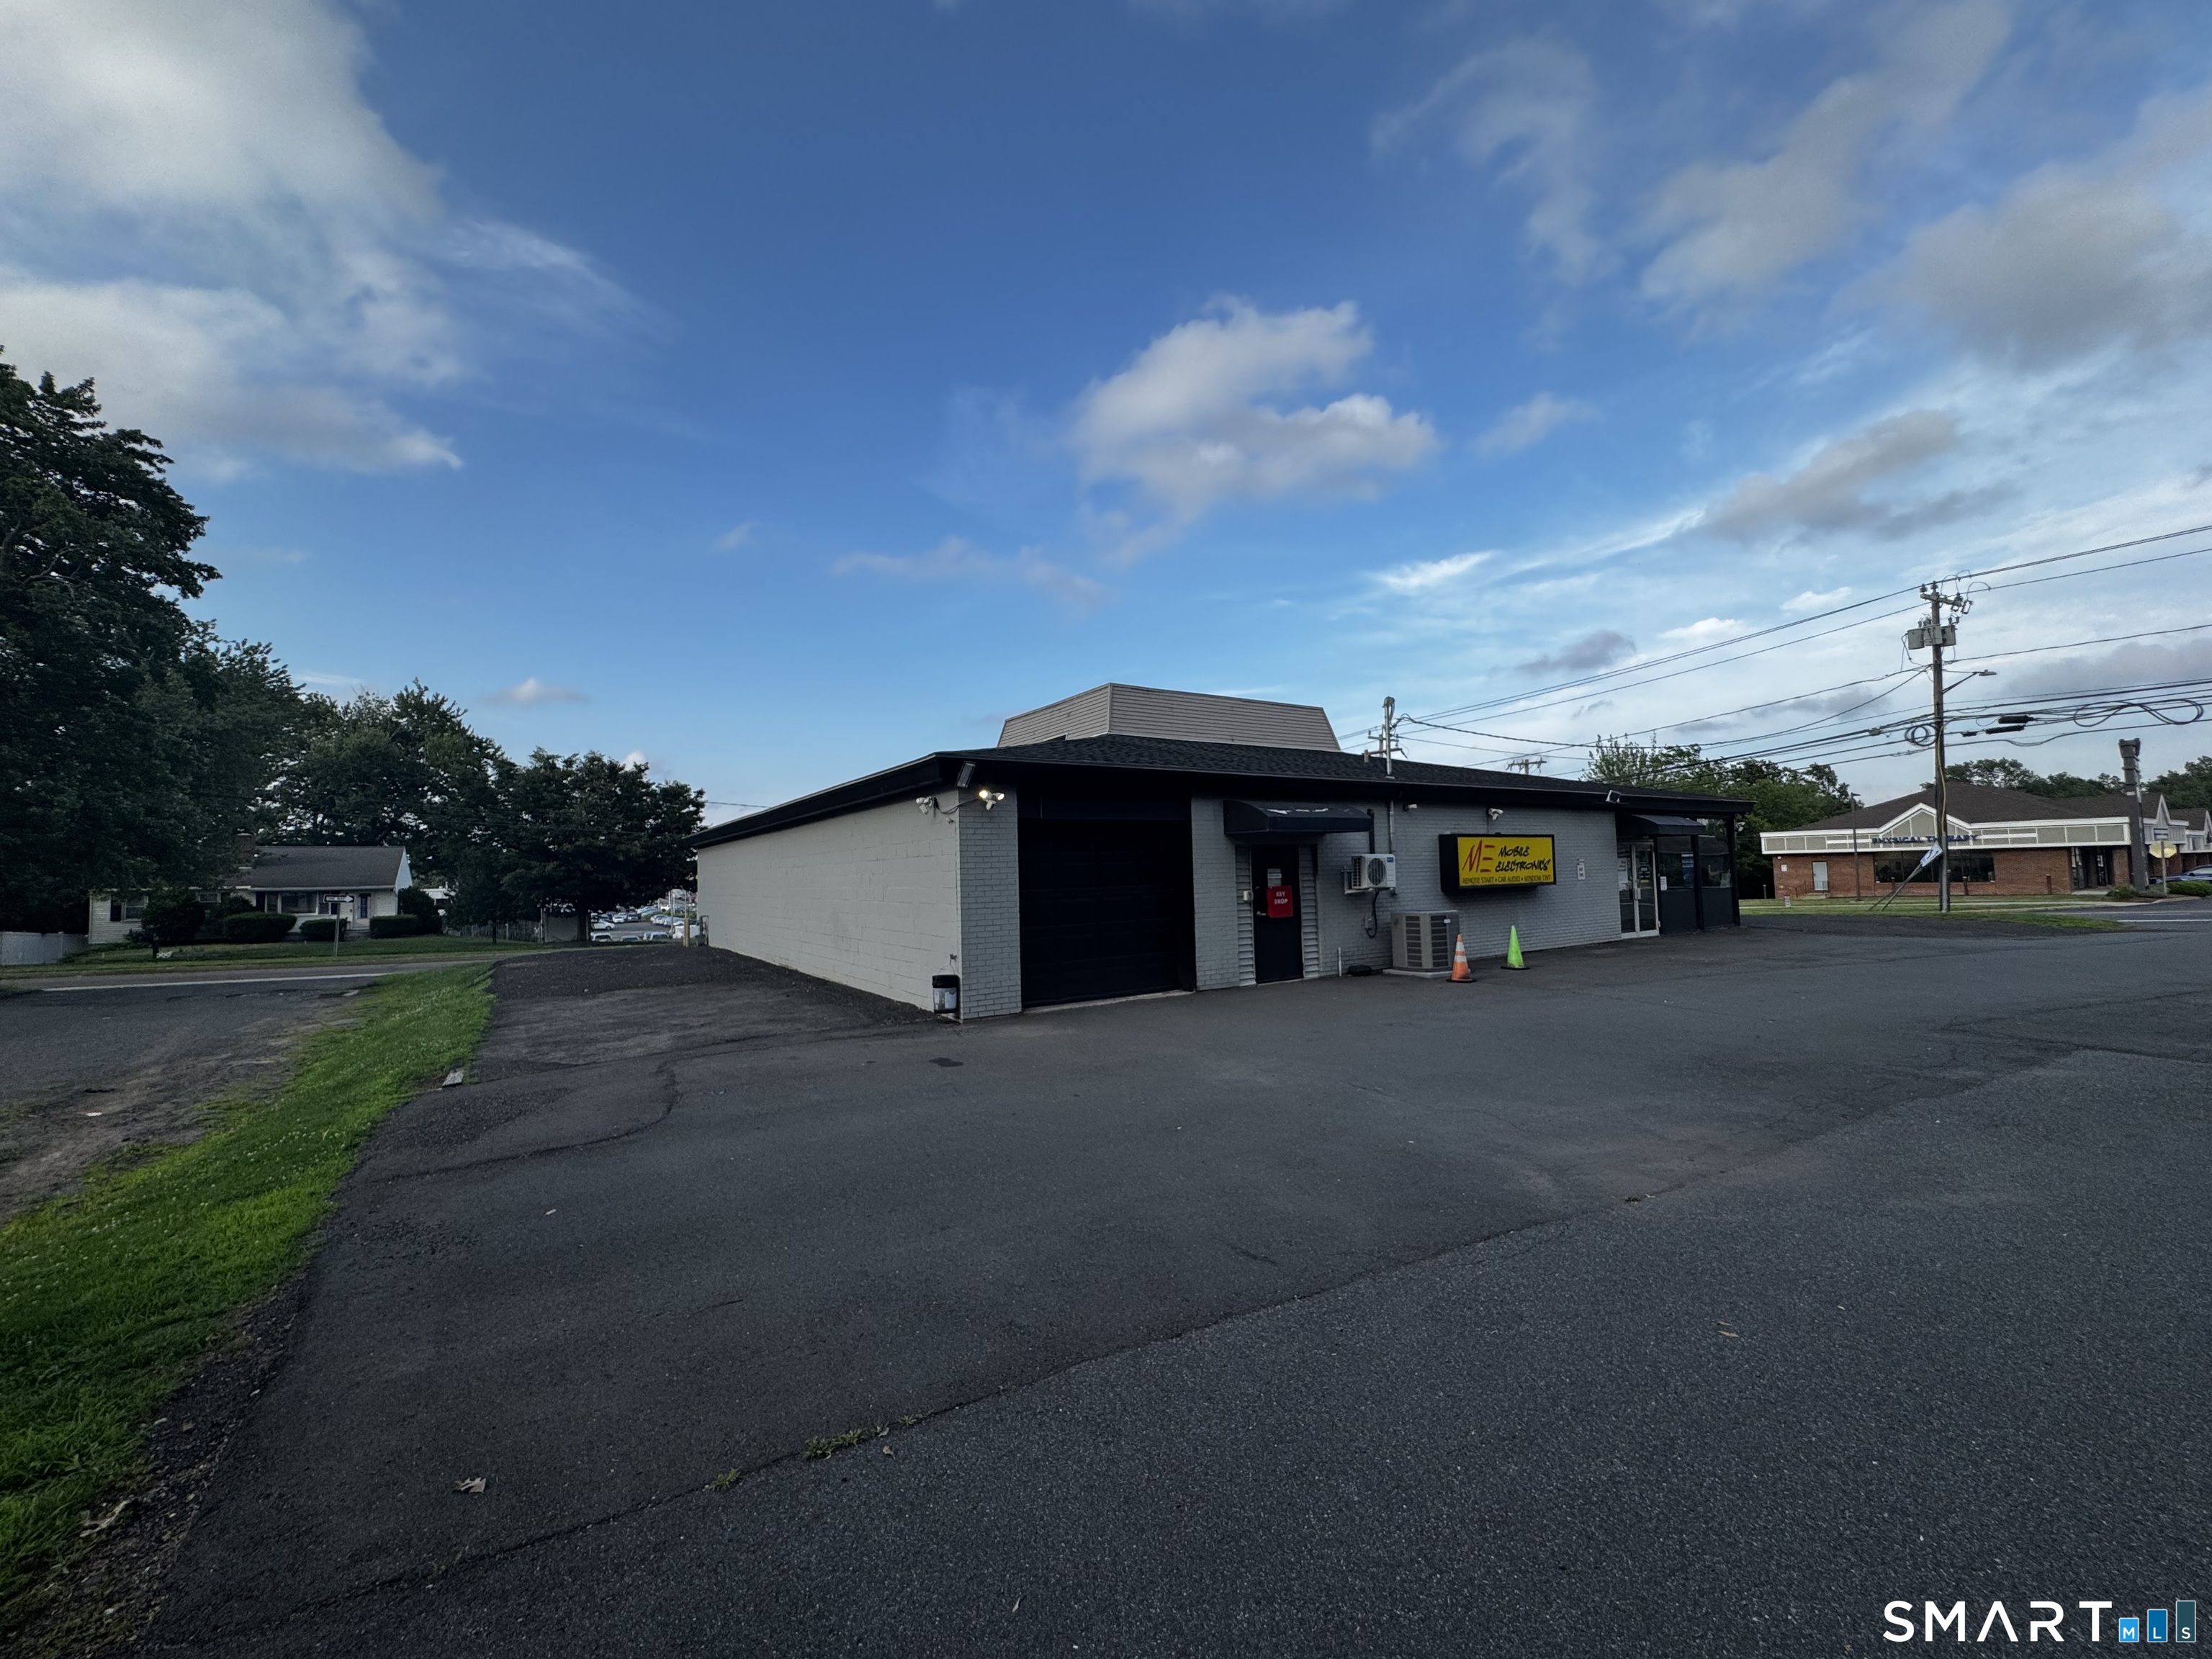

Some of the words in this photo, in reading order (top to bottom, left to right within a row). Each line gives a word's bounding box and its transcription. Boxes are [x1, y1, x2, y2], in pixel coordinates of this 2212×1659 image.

[1462, 839, 1496, 873] ME
[1498, 845, 1529, 858] MOBILE
[1495, 858, 1551, 873] ELECTRONICS
